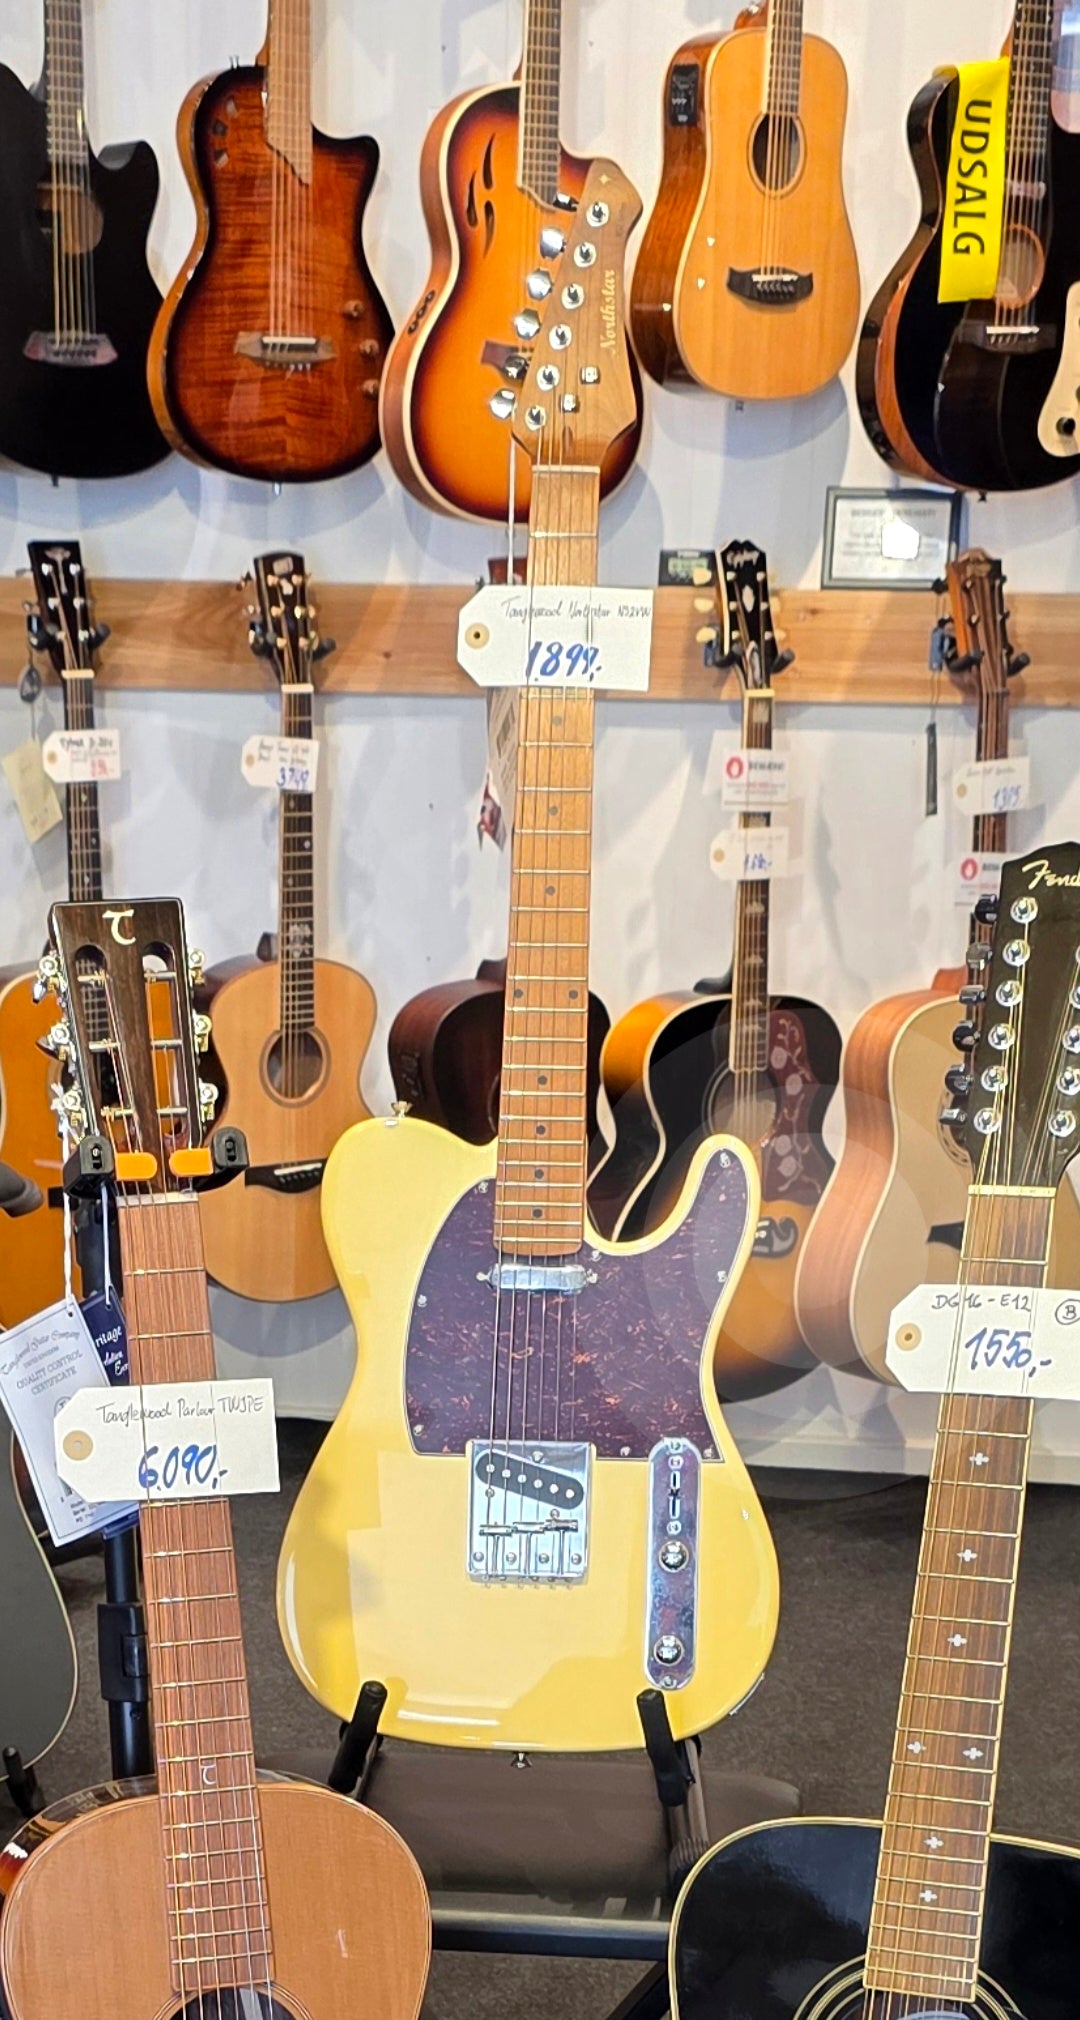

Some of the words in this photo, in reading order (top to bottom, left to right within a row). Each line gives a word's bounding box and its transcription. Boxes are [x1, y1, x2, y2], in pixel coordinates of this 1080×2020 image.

[952, 99, 993, 255] UDSALG
[600, 268, 617, 357] Northstar
[95, 1325, 123, 1348] ritage
[16, 1367, 46, 1390] QUALITY
[47, 1349, 83, 1373] CONTROL
[31, 1365, 78, 1396] CERTIFICATE
